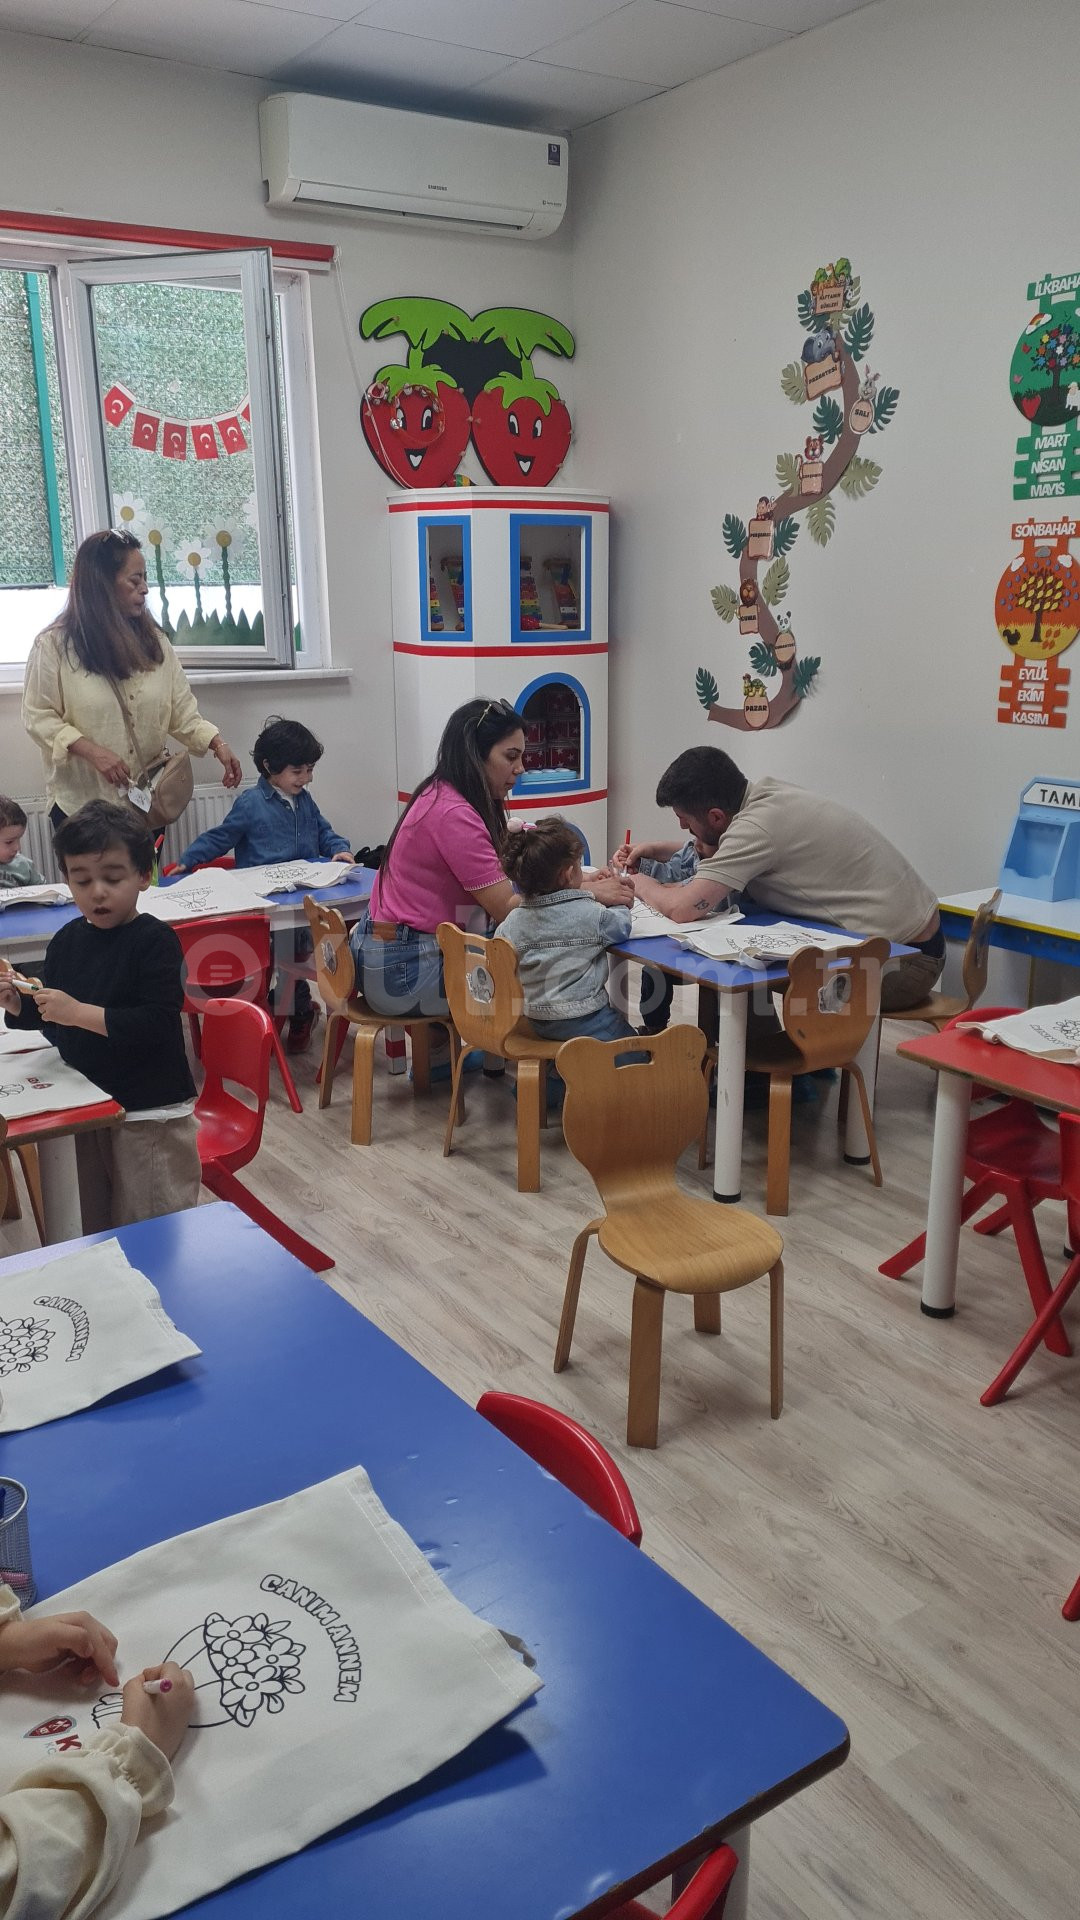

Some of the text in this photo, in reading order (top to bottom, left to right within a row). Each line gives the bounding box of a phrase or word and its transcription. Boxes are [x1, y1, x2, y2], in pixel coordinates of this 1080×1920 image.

[854, 408, 870, 418] SALI
[1034, 433, 1071, 450] MART
[1030, 482, 1066, 497] MAYIS
[1015, 522, 1077, 537] SONBAHAR
[1018, 666, 1049, 681] EYLÜL
[1017, 687, 1045, 702] EKİM
[1040, 788, 1080, 807] TAM
[33, 1296, 82, 1317] CANIM
[260, 1573, 361, 1702] CANIM ANNEM
